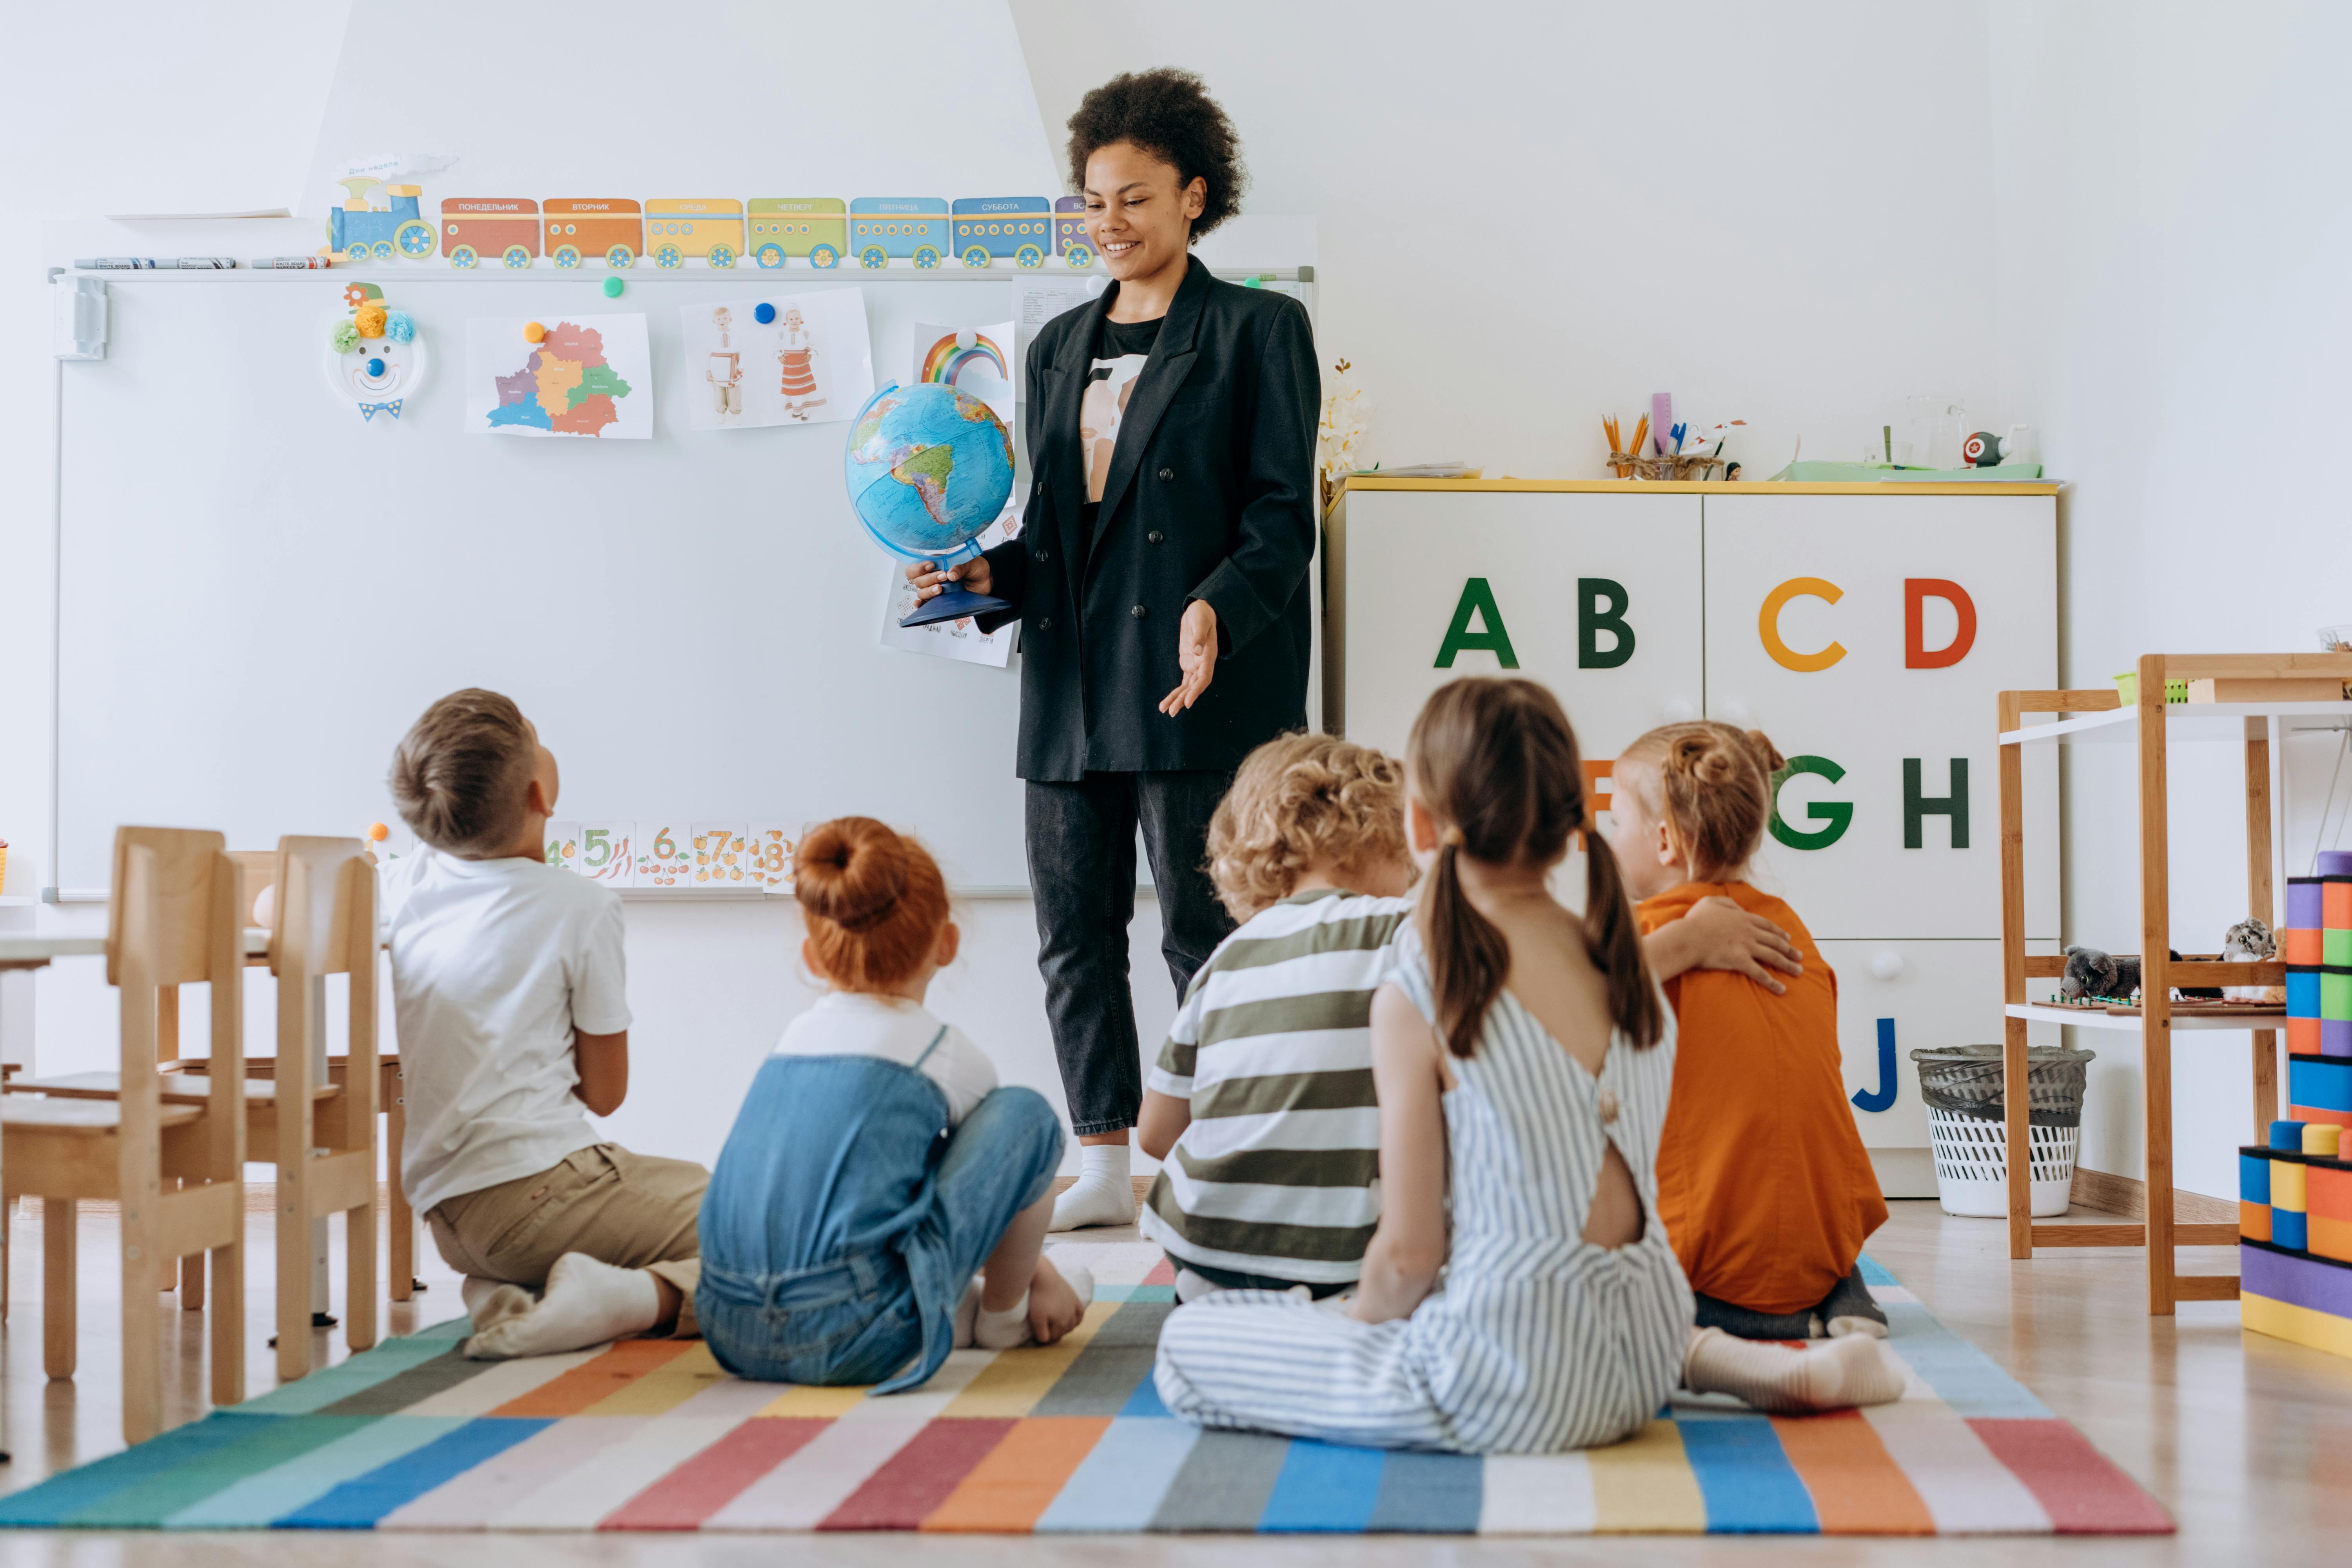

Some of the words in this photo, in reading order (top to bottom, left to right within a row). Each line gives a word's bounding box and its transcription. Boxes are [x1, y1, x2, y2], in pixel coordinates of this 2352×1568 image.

[368, 161, 398, 171] недели
[1434, 578, 1520, 669] A
[1578, 578, 1635, 669] B
[1759, 577, 1848, 672] C
[1904, 578, 1977, 670] D
[545, 840, 564, 868] 4
[584, 829, 611, 866] 5
[654, 827, 675, 859] 6
[708, 831, 732, 862] 7
[764, 843, 784, 872] 8
[1767, 755, 1853, 850] G
[1903, 758, 1969, 848] H
[1851, 1018, 1897, 1112] J
